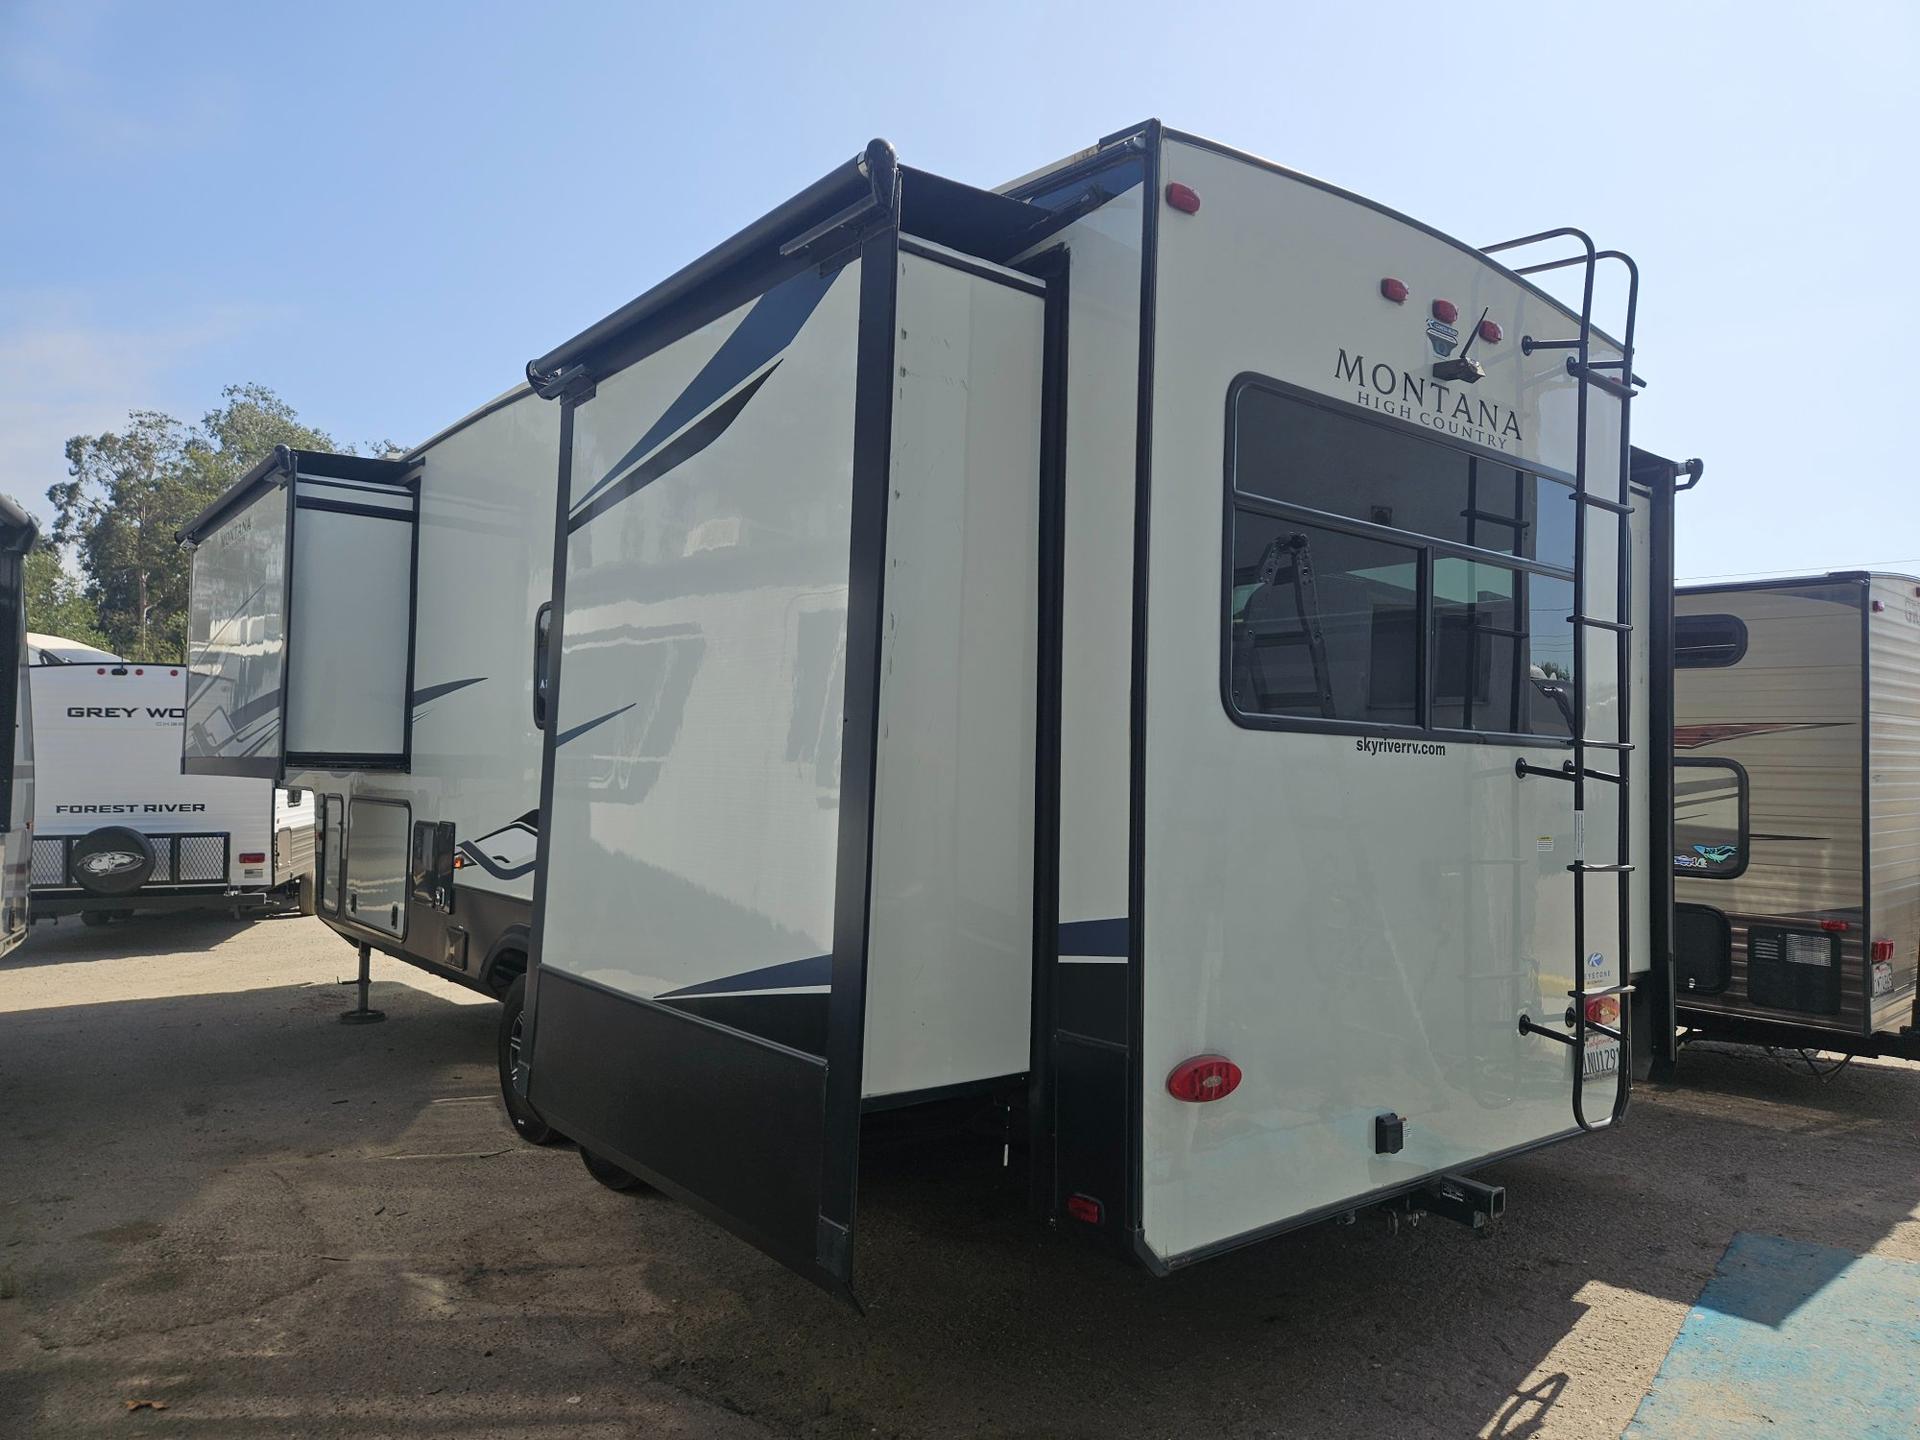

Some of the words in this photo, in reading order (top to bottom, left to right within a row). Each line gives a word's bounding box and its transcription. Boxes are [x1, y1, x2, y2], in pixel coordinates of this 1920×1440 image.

[1333, 347, 1523, 441] MONTANA
[1356, 390, 1412, 419] HIGH
[1419, 411, 1508, 449] COUNTRY
[67, 707, 140, 718] GREY
[1356, 736, 1446, 756] skyriverrv.com
[56, 804, 139, 814] FOREST
[143, 803, 206, 813] RIVER
